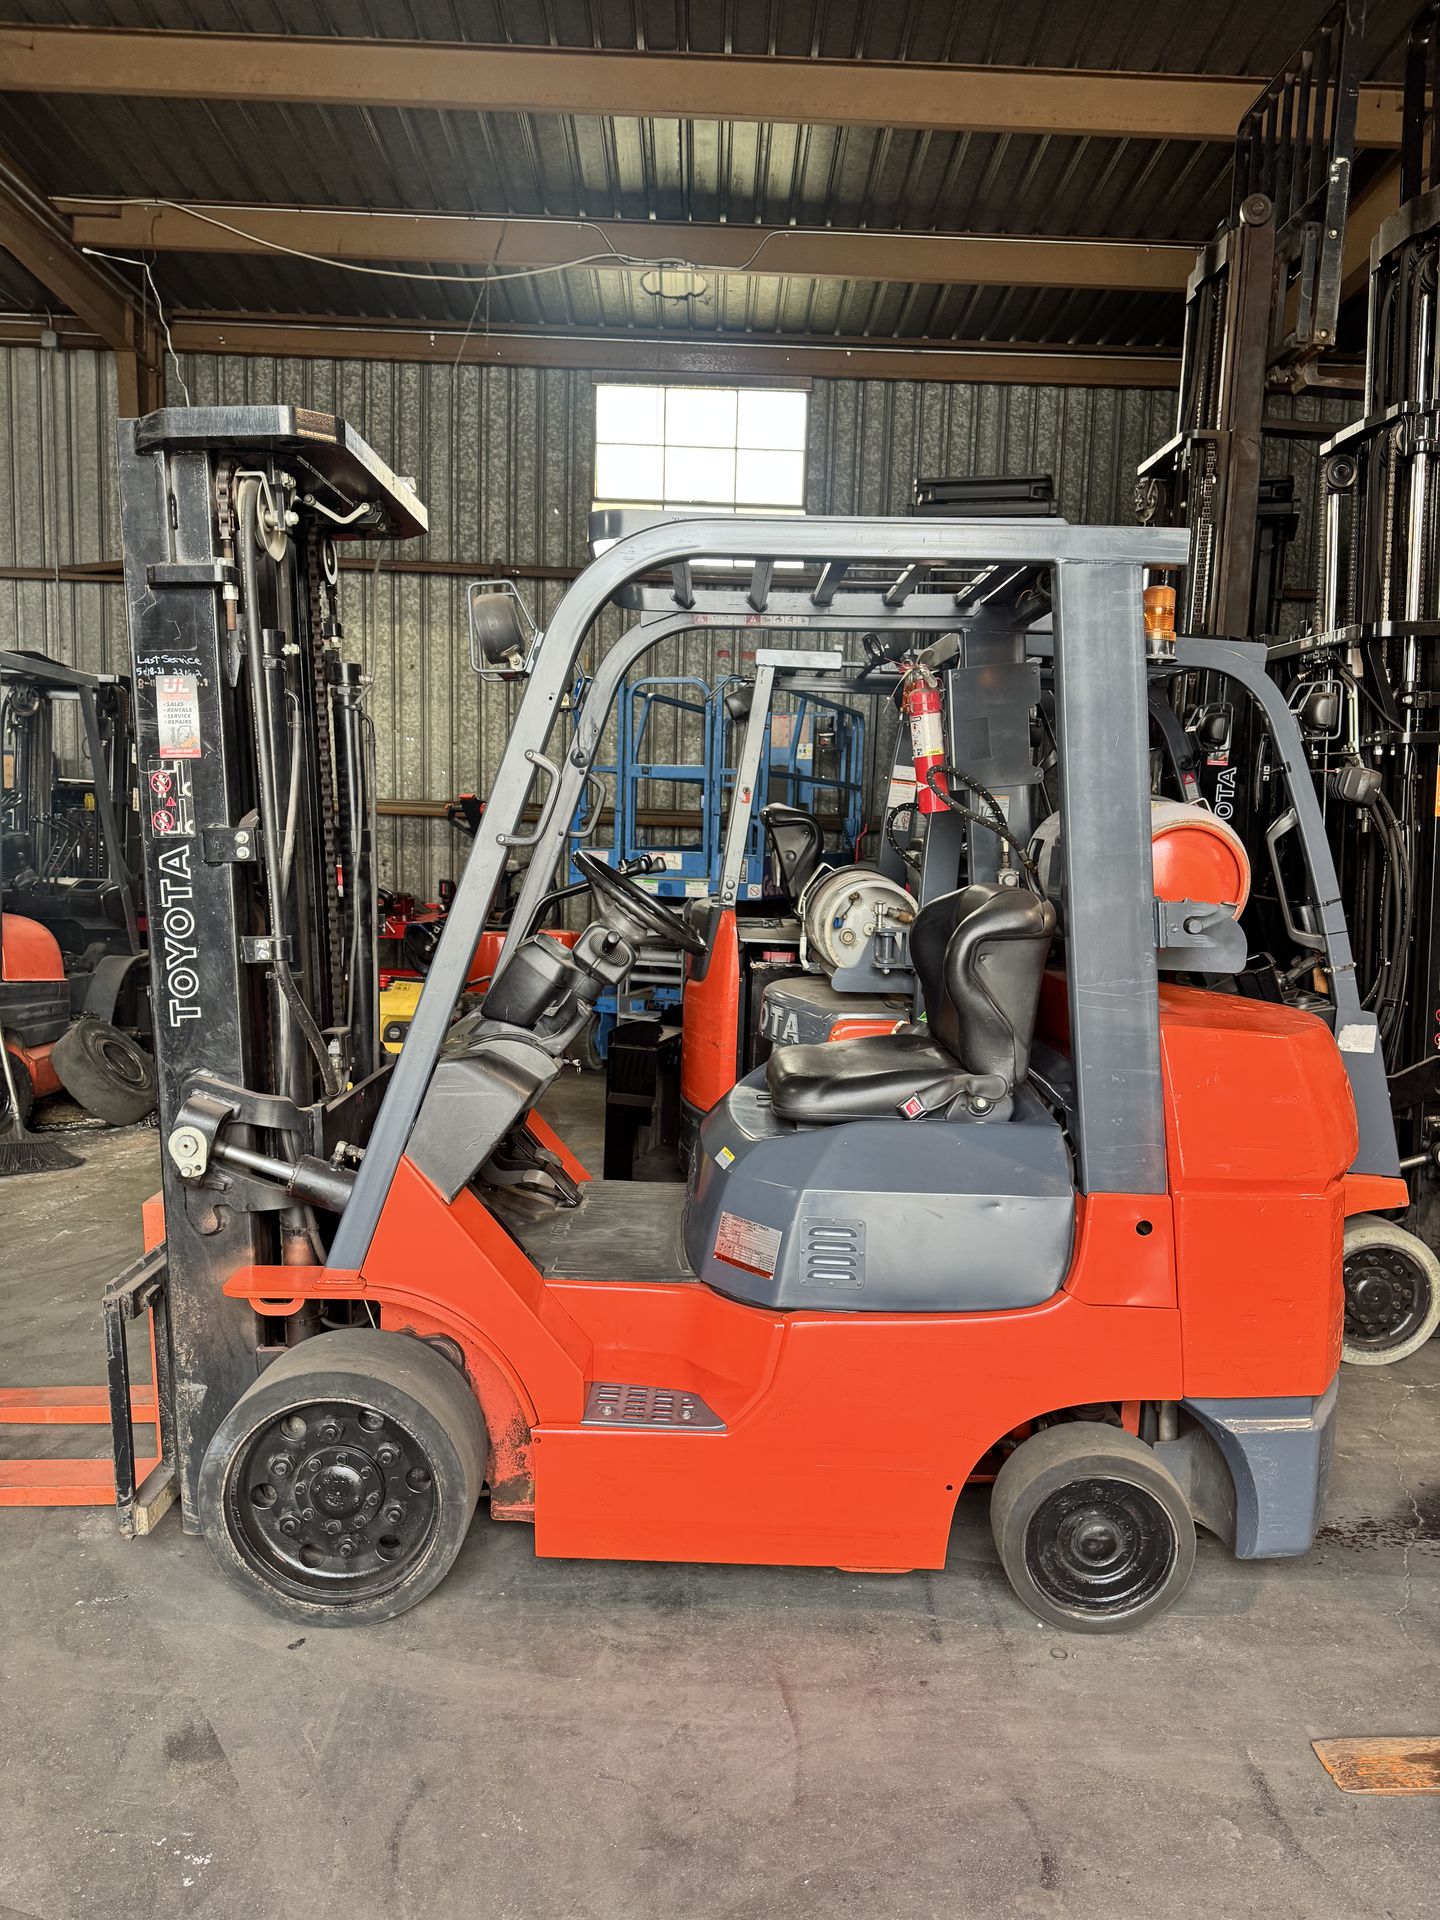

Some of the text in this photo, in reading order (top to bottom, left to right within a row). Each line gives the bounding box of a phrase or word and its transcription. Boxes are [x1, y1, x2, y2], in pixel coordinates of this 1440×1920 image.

[137, 654, 202, 666] Last Service
[164, 678, 190, 692] UL
[159, 845, 201, 1027] TOYOTA
